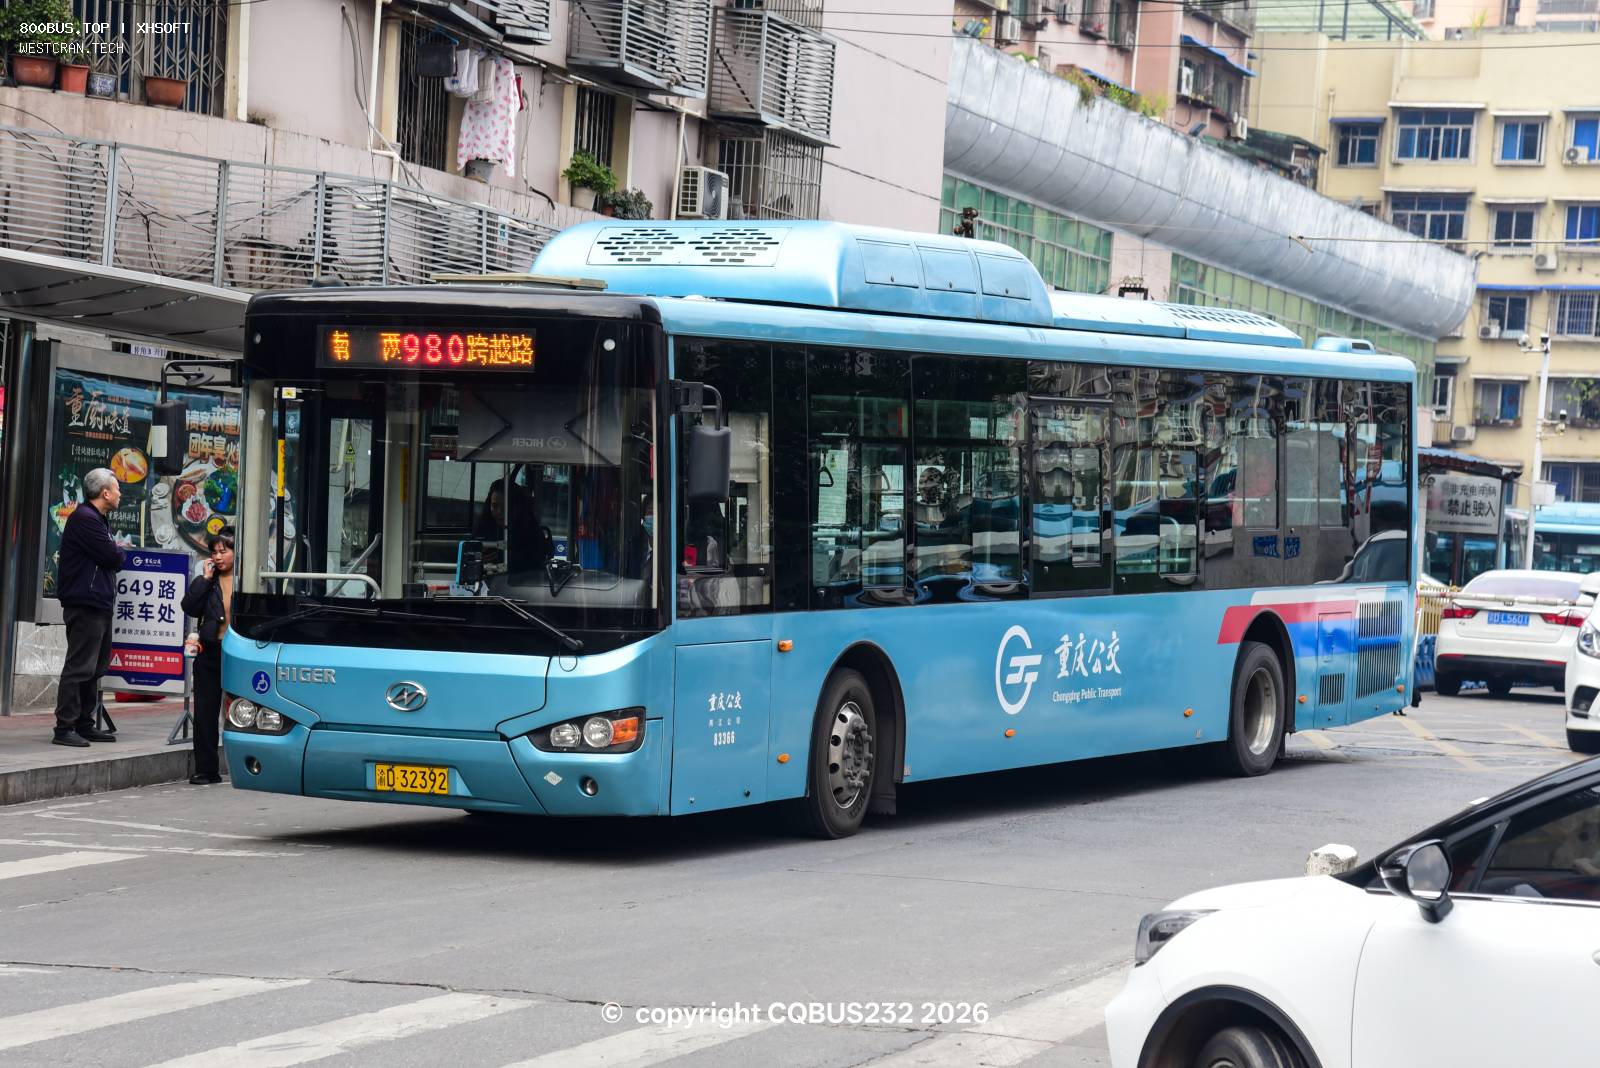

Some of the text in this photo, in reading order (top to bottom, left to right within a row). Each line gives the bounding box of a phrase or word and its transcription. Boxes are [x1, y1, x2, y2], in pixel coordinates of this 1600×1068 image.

[1447, 499, 1496, 518] 禁止驶入
[116, 601, 176, 624] 乘车处
[1054, 630, 1122, 679] 重庆公交
[276, 666, 336, 684] HIGER
[708, 690, 742, 712] 重庆公交
[1052, 687, 1122, 704] Chongqing Public Transport
